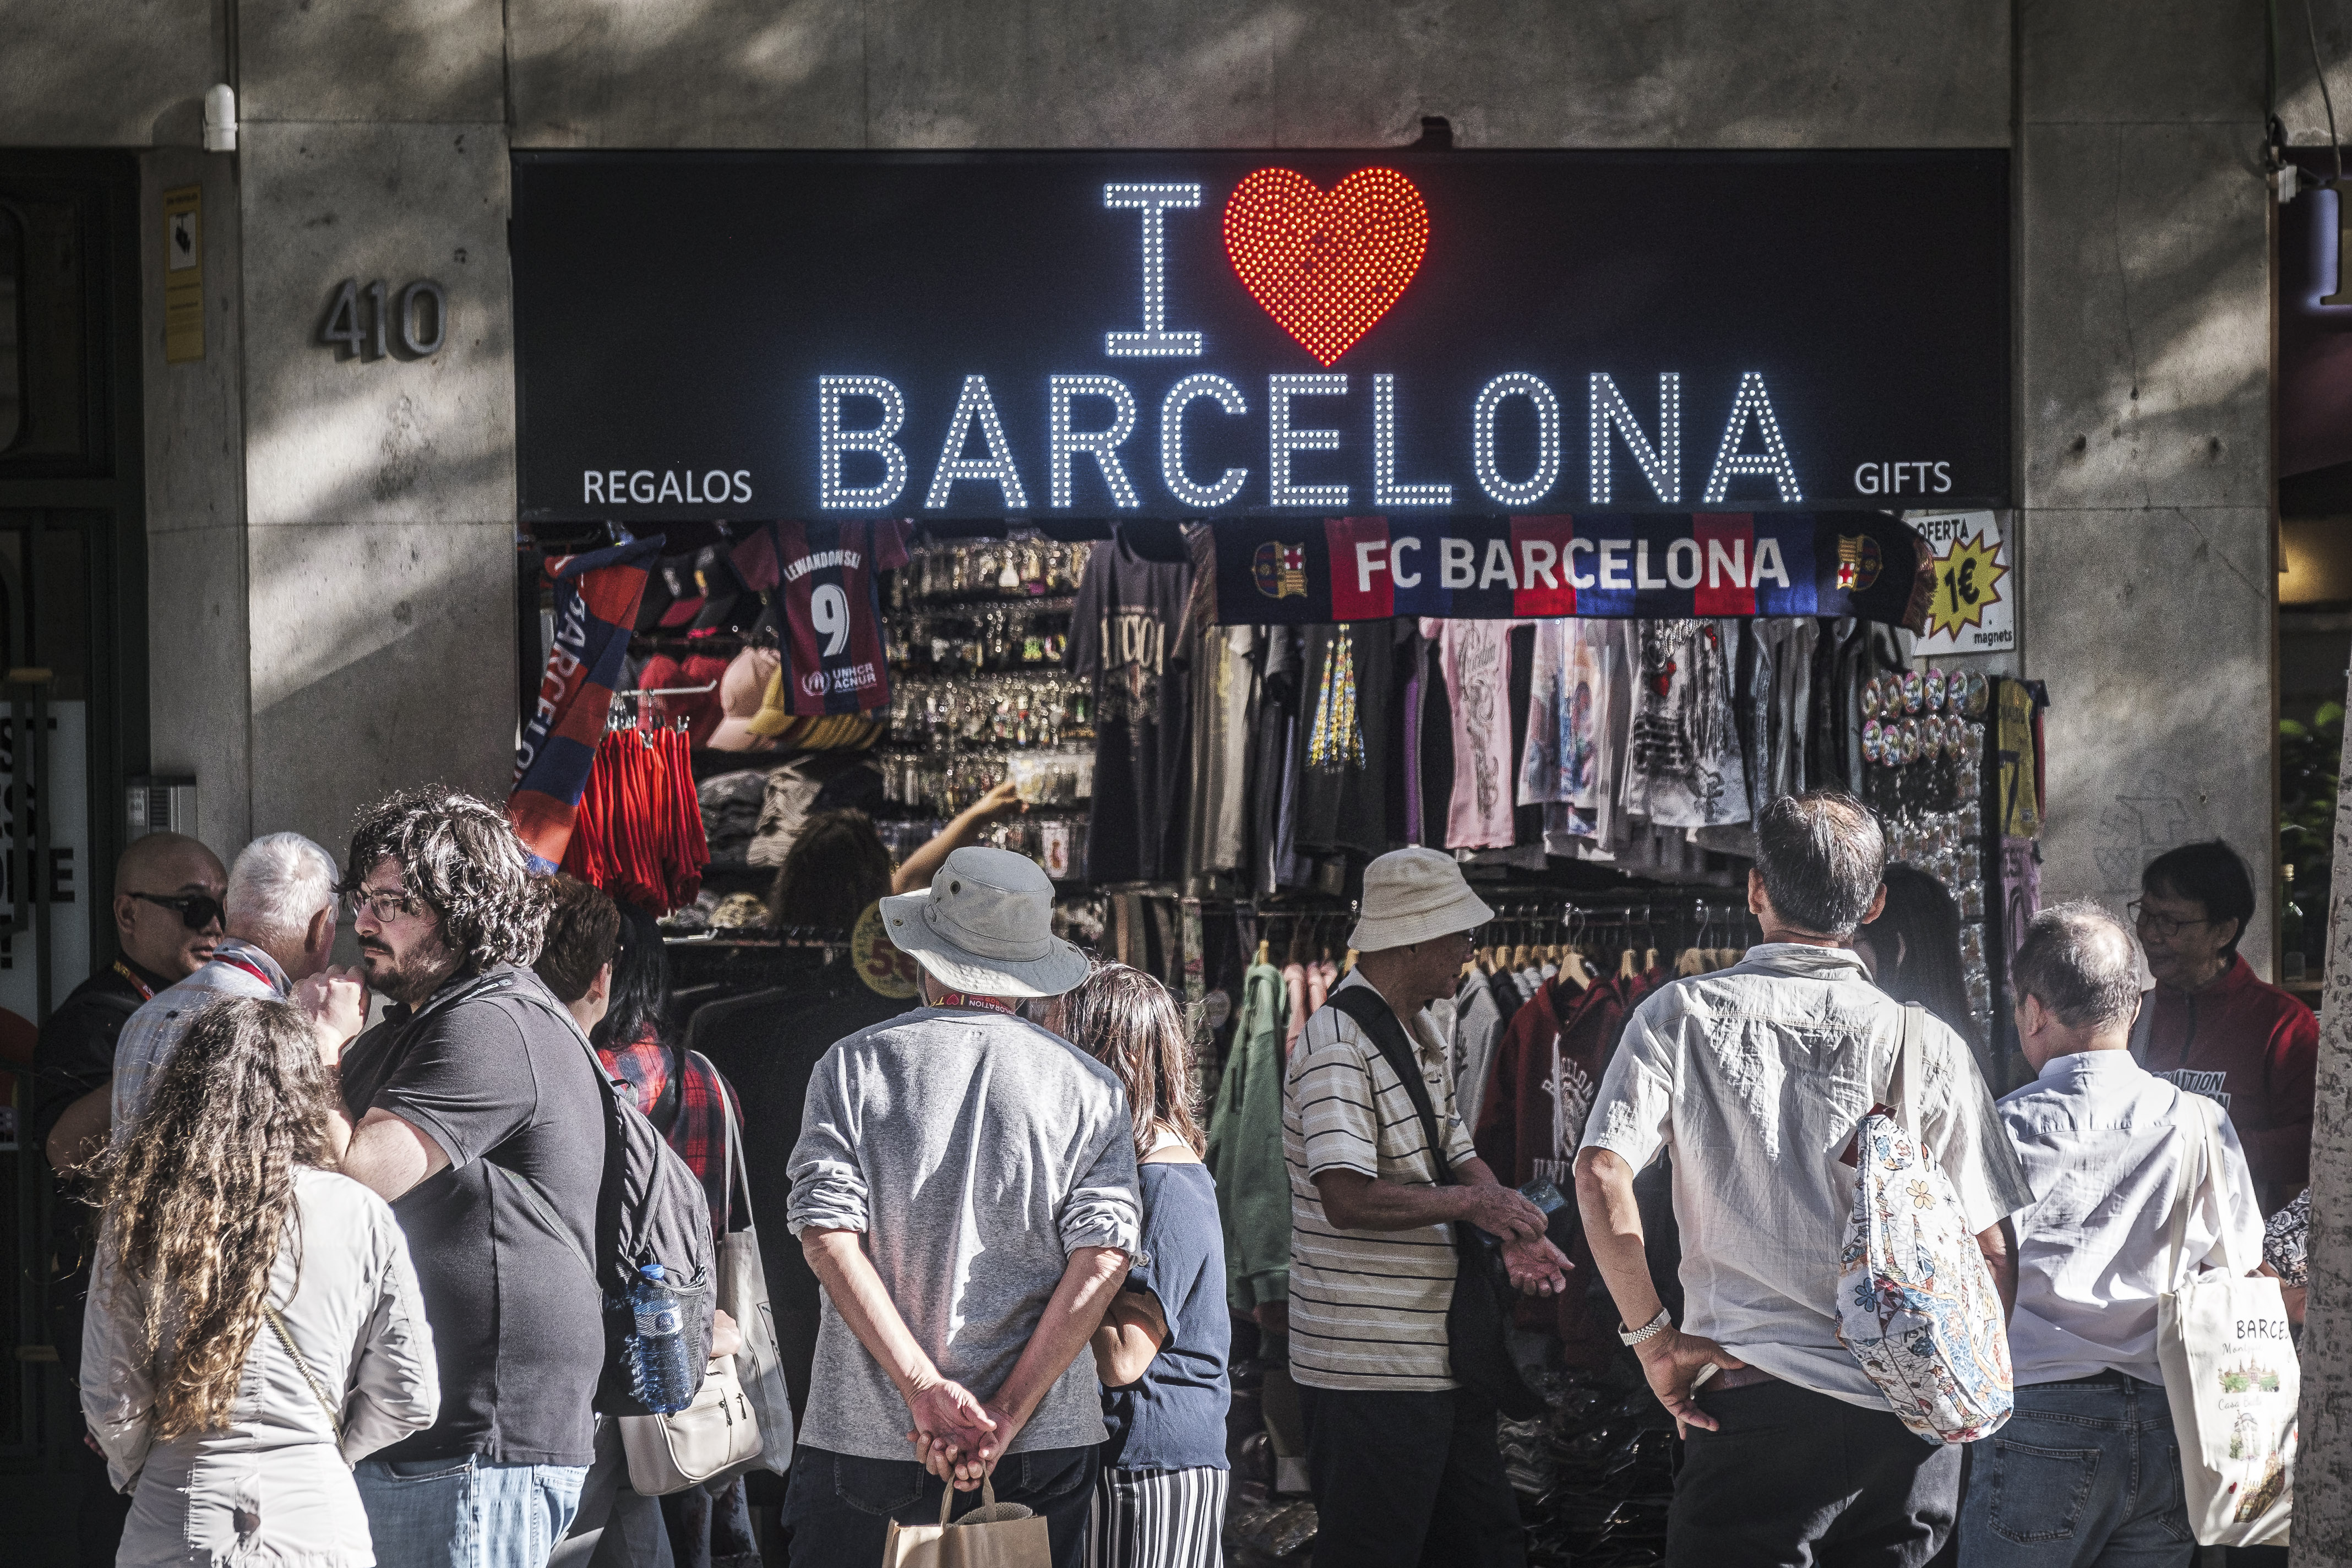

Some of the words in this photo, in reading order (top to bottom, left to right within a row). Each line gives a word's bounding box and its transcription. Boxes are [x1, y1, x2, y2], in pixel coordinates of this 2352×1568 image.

[1103, 183, 1201, 357] I
[320, 279, 444, 359] 410
[819, 372, 1803, 508] BARCELONA
[584, 470, 753, 504] REGALOS
[1854, 460, 1952, 496] GIFTS
[1917, 518, 1969, 542] OFERTA
[1355, 536, 1422, 592] FC
[1440, 536, 1790, 590] BARCELONA
[1944, 557, 1980, 613] 1€
[810, 582, 850, 657] 9
[1974, 629, 2013, 646] magnets
[511, 590, 586, 791] BARCELO
[2236, 1319, 2289, 1340] BARCE
[2218, 1398, 2240, 1411] Casa
